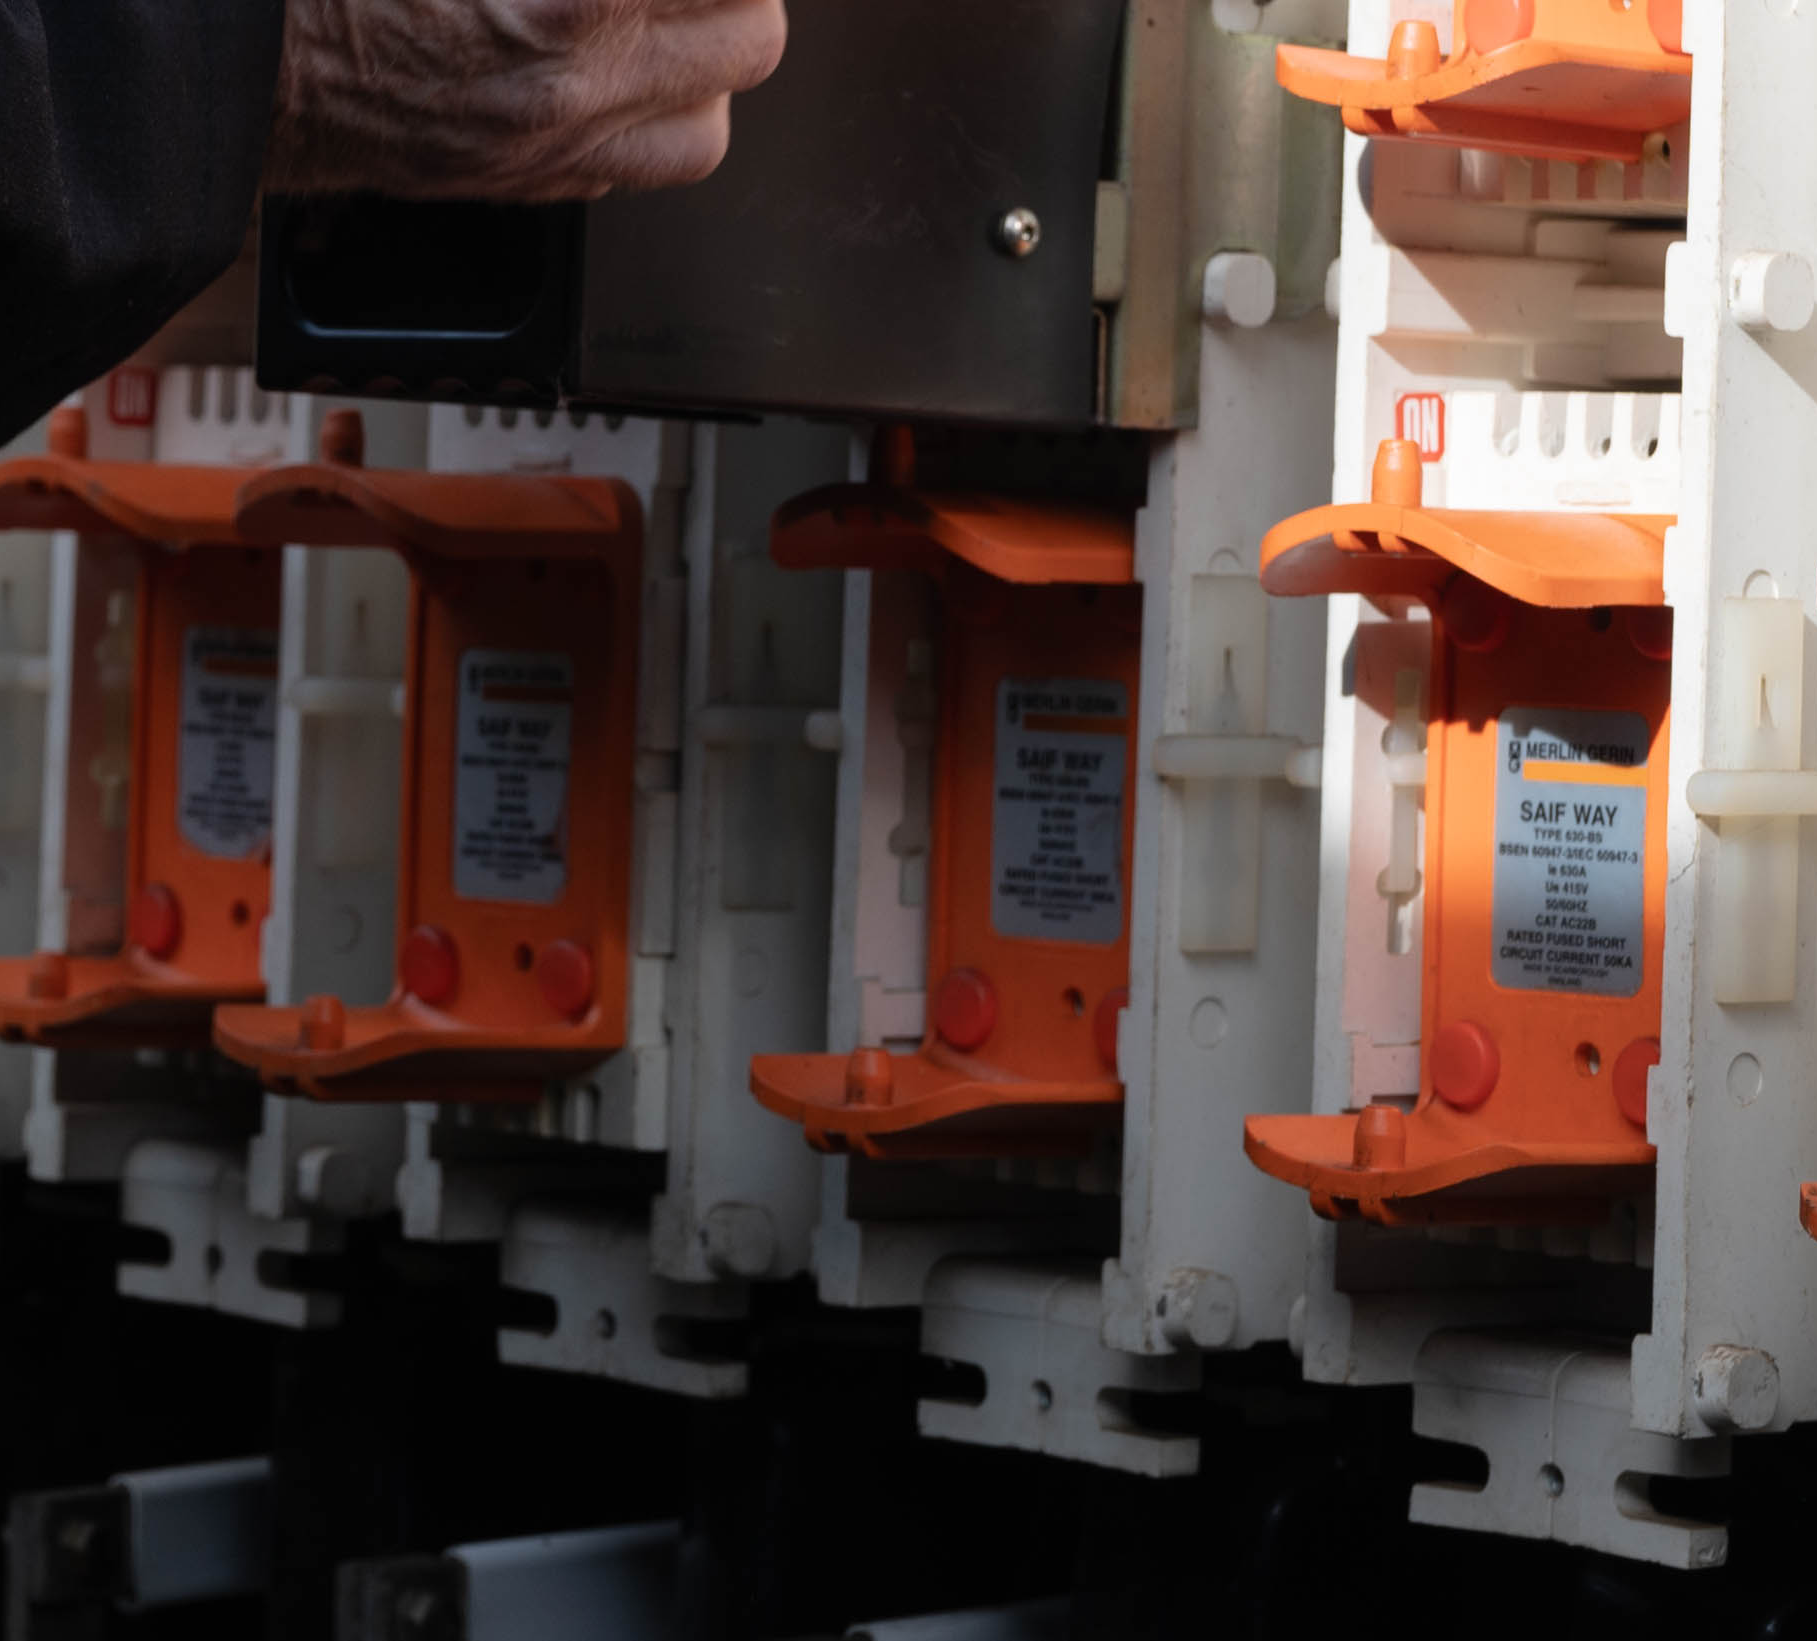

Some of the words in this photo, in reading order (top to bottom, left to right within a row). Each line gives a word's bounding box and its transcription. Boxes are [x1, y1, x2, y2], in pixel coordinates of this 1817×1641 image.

[1403, 396, 1439, 453] ON
[1526, 740, 1583, 761] MERLIN
[1521, 800, 1566, 823] SAIF
[1573, 803, 1617, 826] WAY
